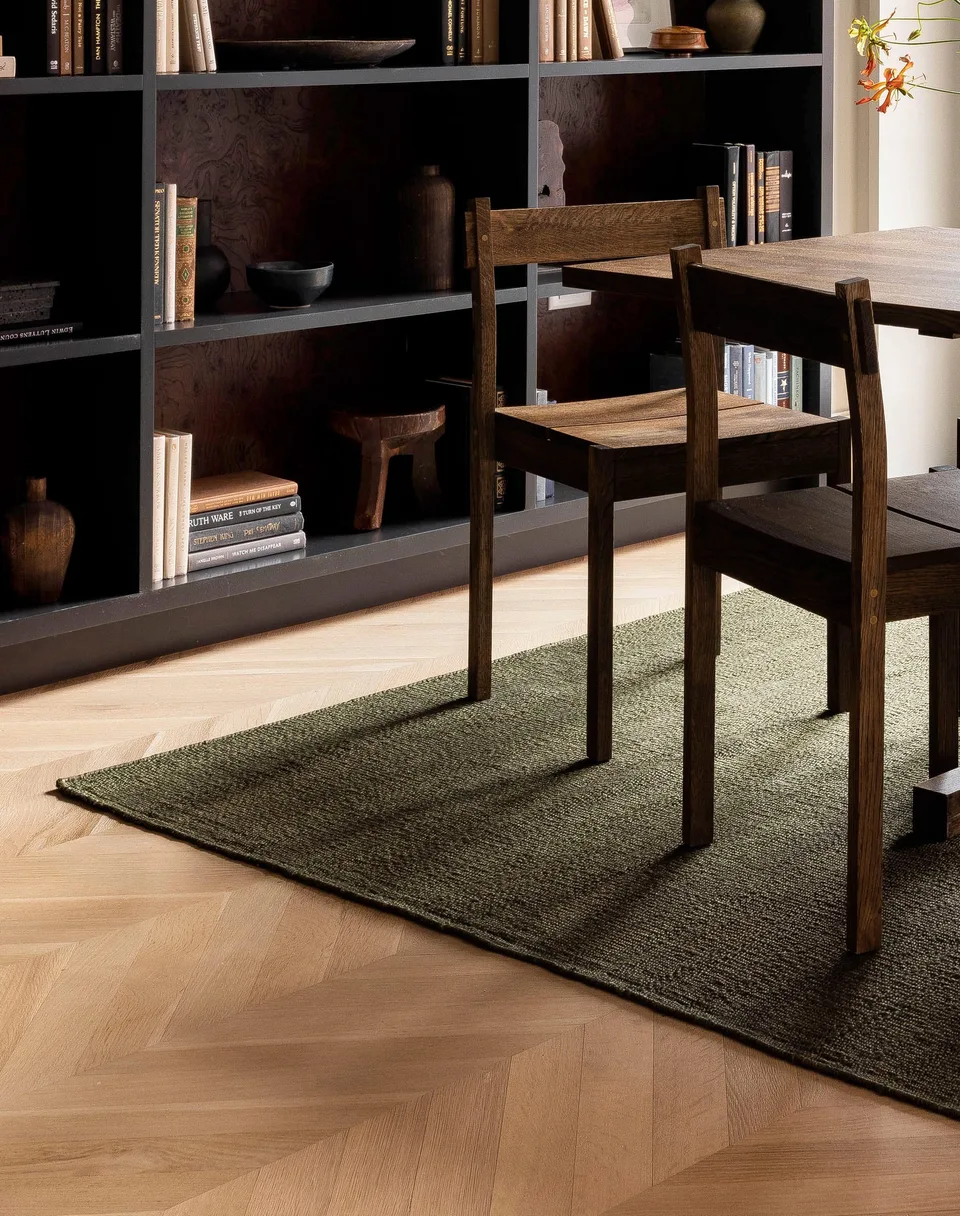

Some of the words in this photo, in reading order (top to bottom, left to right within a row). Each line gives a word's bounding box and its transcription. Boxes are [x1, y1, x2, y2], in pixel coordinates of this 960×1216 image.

[202, 6, 208, 17] ME
[50, 10, 58, 34] Sedaris
[19, 329, 50, 339] LUTYENS
[51, 326, 74, 334] EDWIN
[188, 516, 209, 528] RUTH
[211, 511, 234, 524] WARE
[242, 508, 255, 516] TURN
[271, 503, 282, 511] KEY
[193, 534, 218, 545] STEPHEN
[219, 531, 234, 541] KING
[231, 548, 248, 557] WATCH
[257, 542, 282, 552] DISAPPEAR
